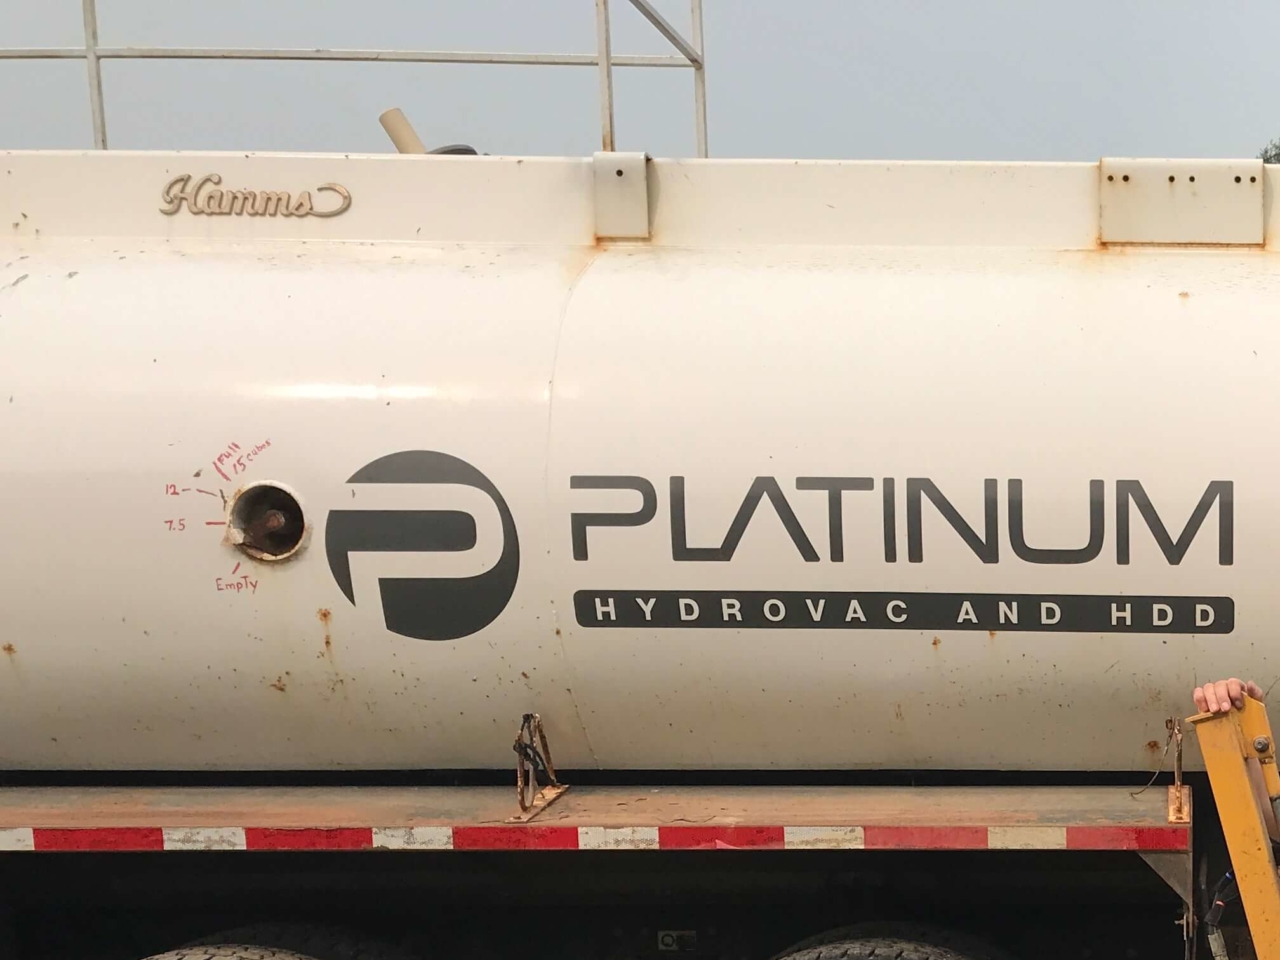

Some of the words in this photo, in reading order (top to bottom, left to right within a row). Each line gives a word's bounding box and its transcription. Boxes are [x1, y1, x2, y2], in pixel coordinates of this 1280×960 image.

[158, 173, 352, 218] Hamms
[232, 455, 247, 475] 15
[165, 484, 180, 496] 12
[164, 518, 185, 531] 7.5
[570, 475, 1234, 566] PLATINUM
[595, 597, 909, 624] HYDROVAC
[957, 600, 1063, 626] AND
[1110, 602, 1217, 628] HDD
